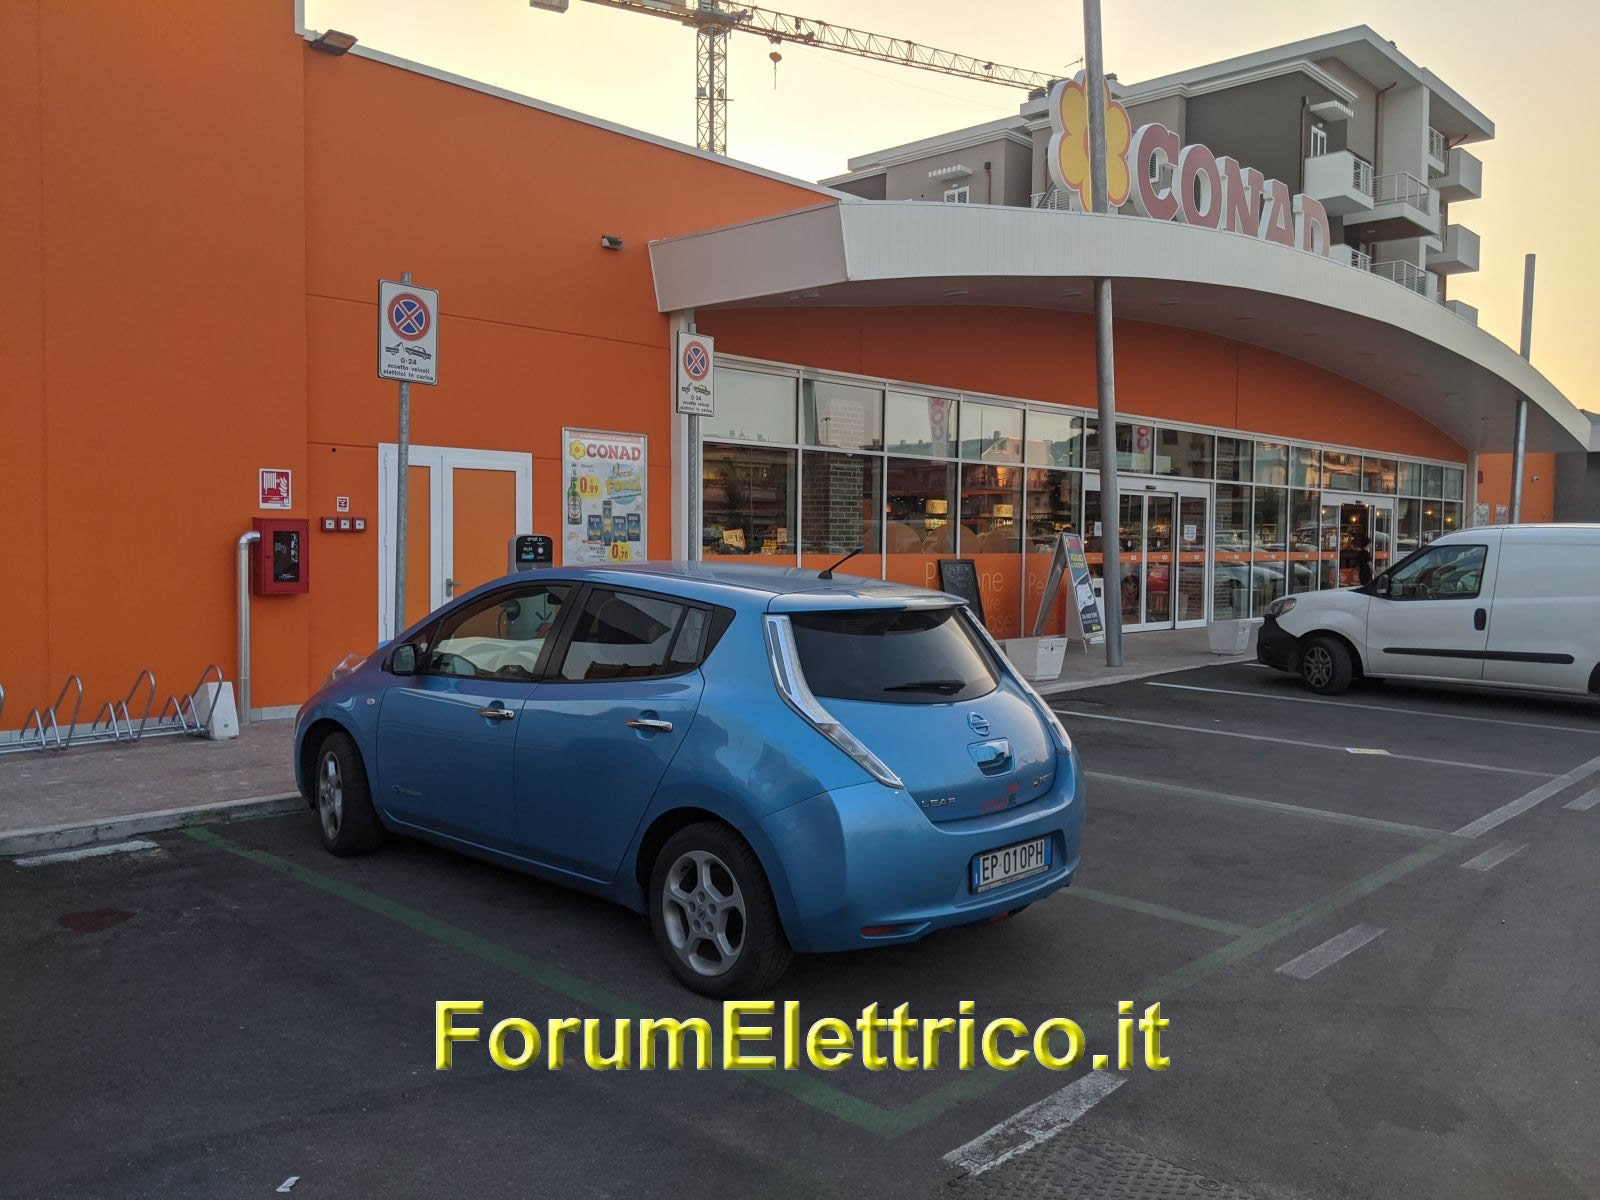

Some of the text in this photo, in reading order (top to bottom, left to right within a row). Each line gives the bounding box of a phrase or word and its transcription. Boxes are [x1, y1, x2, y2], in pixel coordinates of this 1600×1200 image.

[1129, 122, 1331, 258] CONAD
[586, 443, 642, 461] CONAD
[921, 796, 956, 808] LEAF
[982, 855, 999, 881] EP
